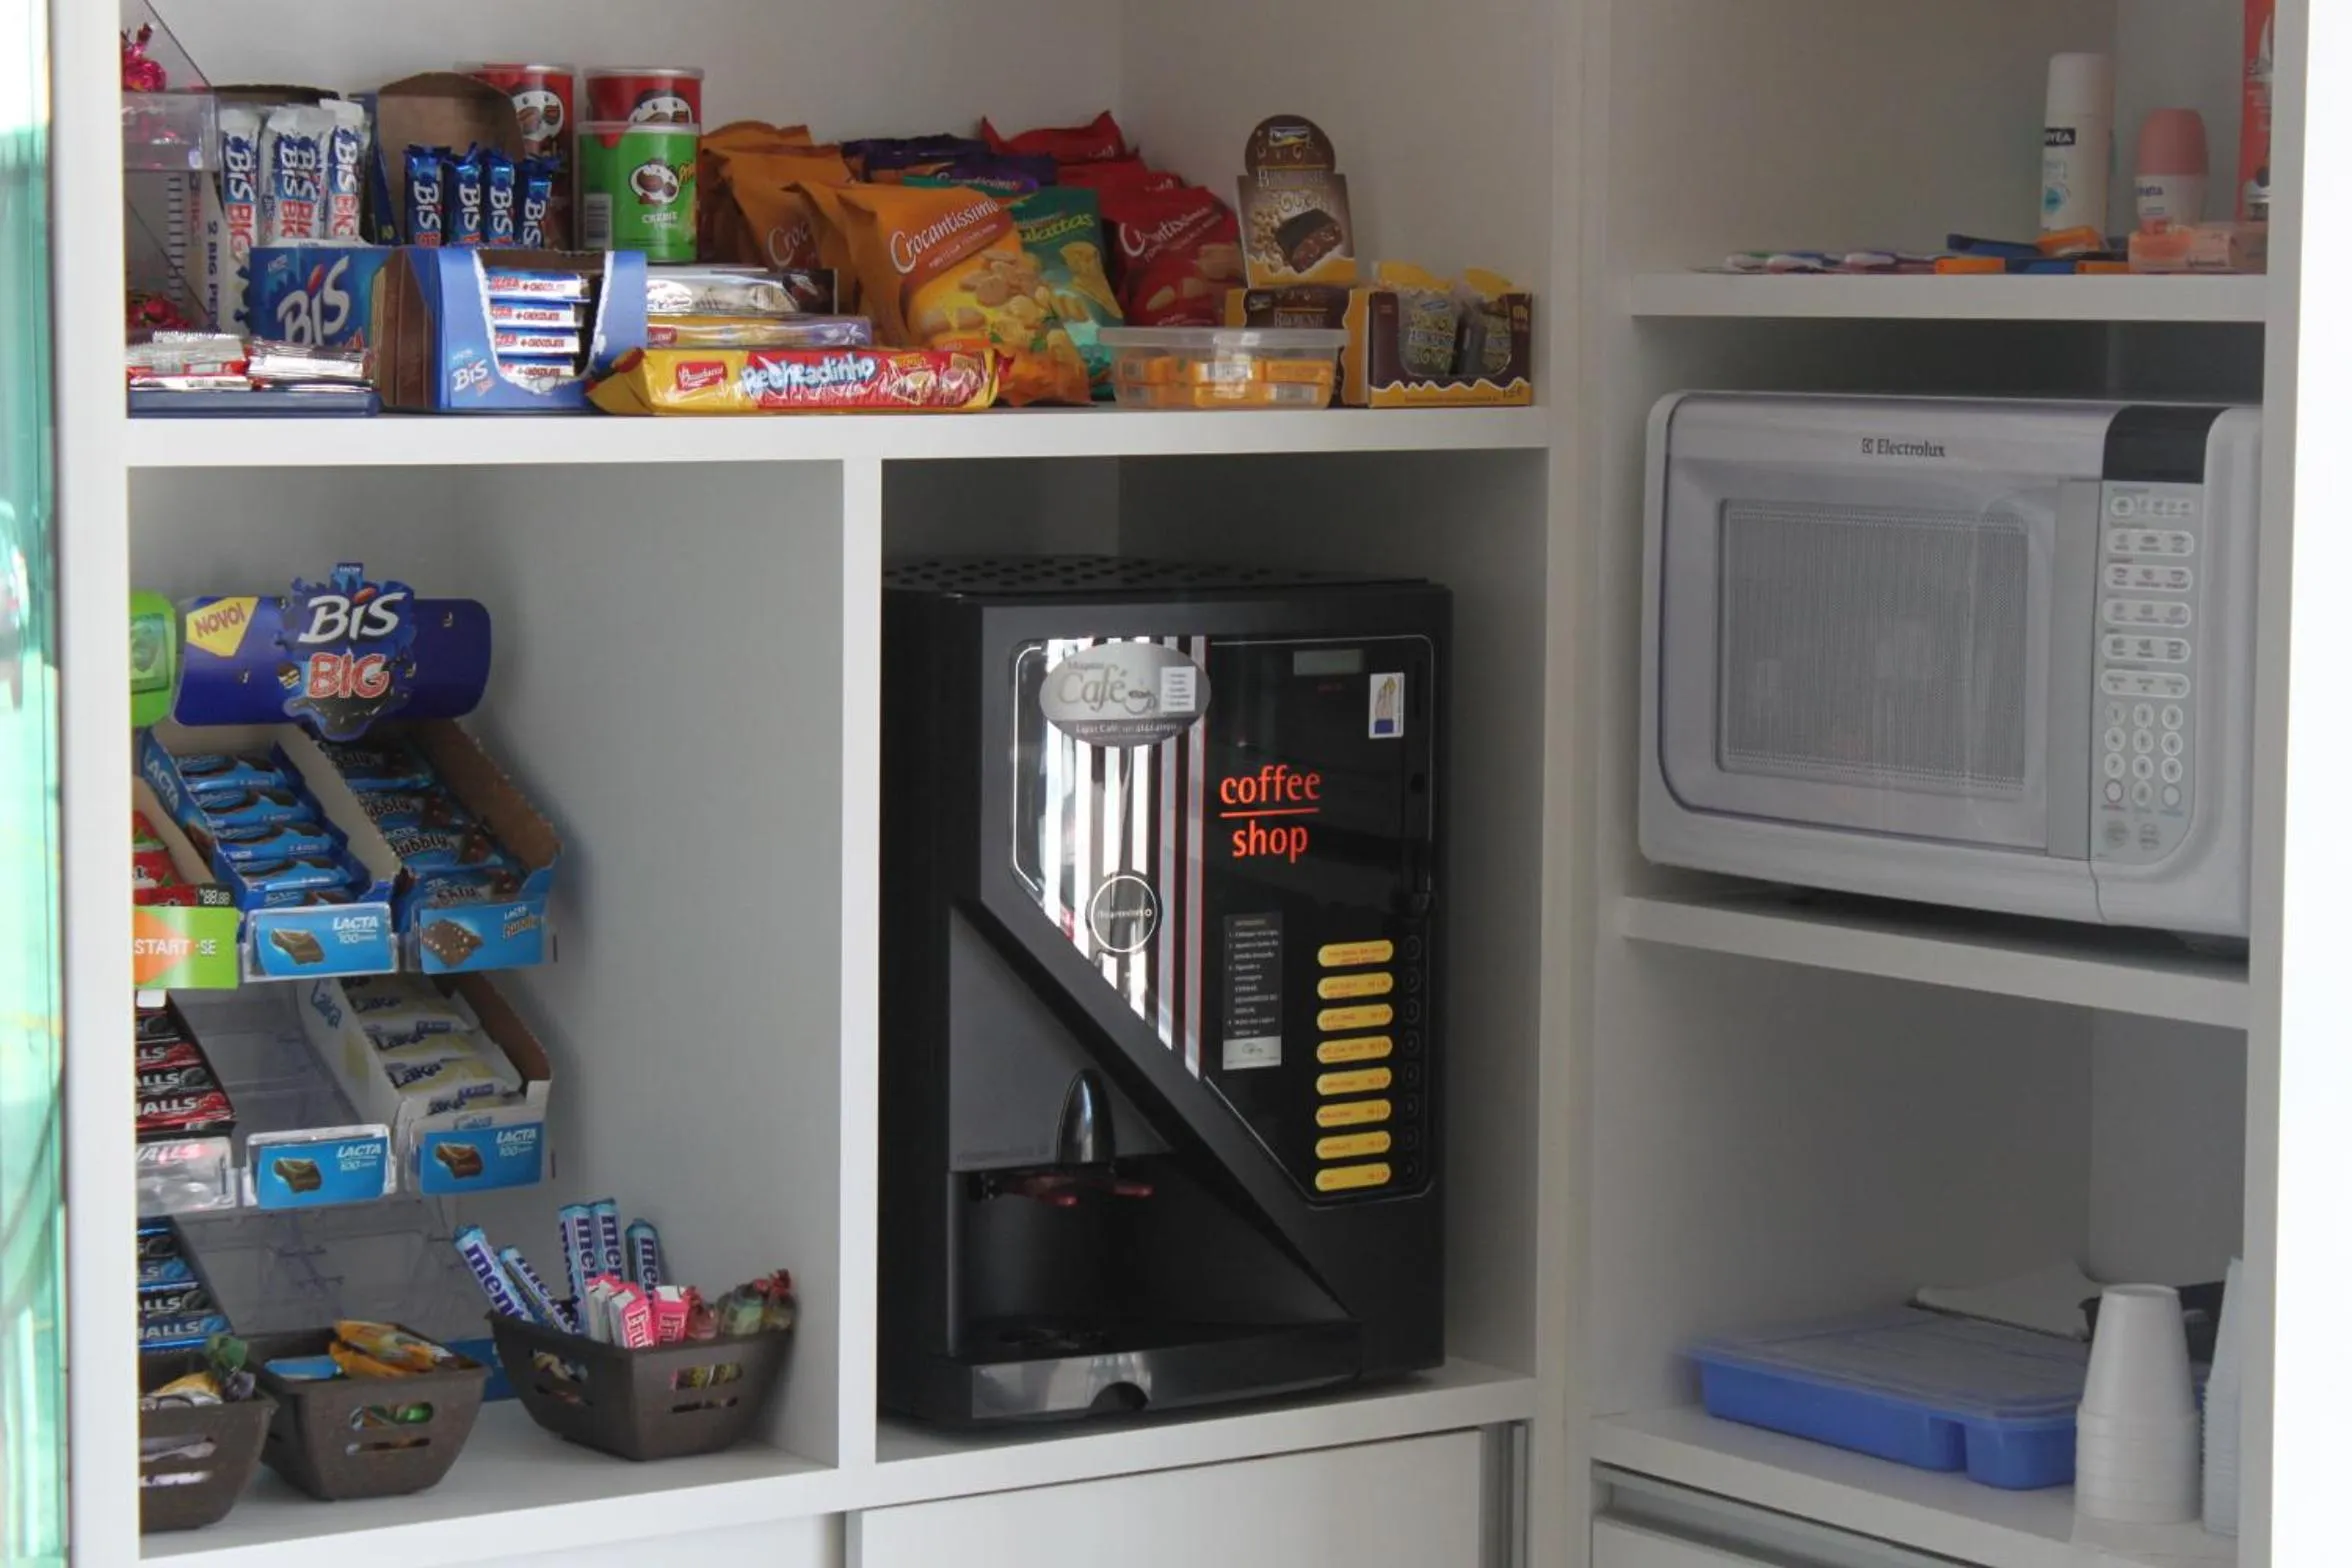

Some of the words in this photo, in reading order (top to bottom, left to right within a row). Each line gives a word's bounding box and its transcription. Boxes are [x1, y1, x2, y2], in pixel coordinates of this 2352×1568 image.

[1877, 437, 1946, 458] Electrolux
[194, 602, 246, 637] NOVO!
[307, 652, 390, 699] BIG
[1057, 663, 1129, 712] Café
[1220, 764, 1321, 805] coffee
[1232, 819, 1309, 864] shop
[333, 916, 379, 931] LACTA
[337, 1144, 381, 1159] LACTA
[496, 1129, 537, 1144] LACTA
